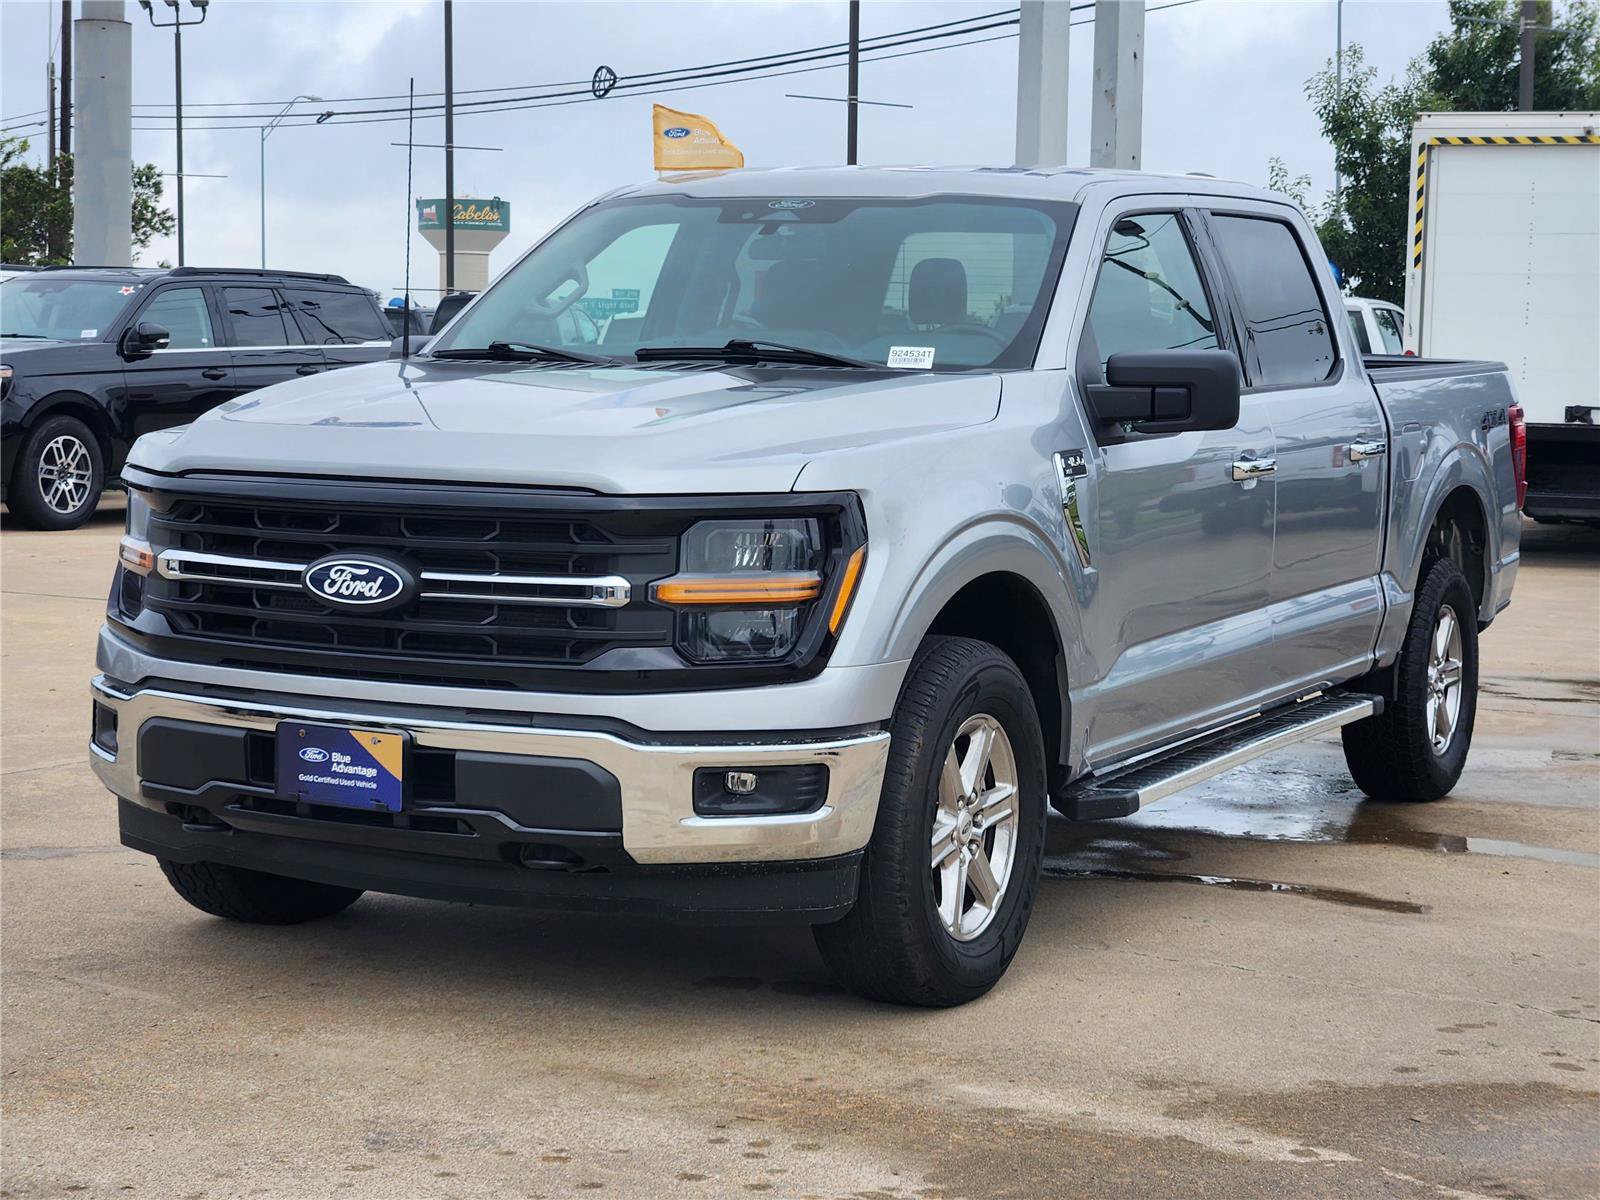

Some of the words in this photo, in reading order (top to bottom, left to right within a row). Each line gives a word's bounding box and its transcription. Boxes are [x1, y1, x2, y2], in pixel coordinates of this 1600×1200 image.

[453, 204, 501, 221] Cabela's
[891, 350, 933, 358] 924534T
[323, 565, 384, 598] Ford
[304, 749, 324, 760] Ford
[331, 752, 352, 763] Blue
[331, 763, 377, 777] Advantage
[298, 773, 313, 781] Gold
[314, 775, 339, 784] Certified
[339, 778, 355, 787] Used
[355, 780, 377, 789] Vehicle
